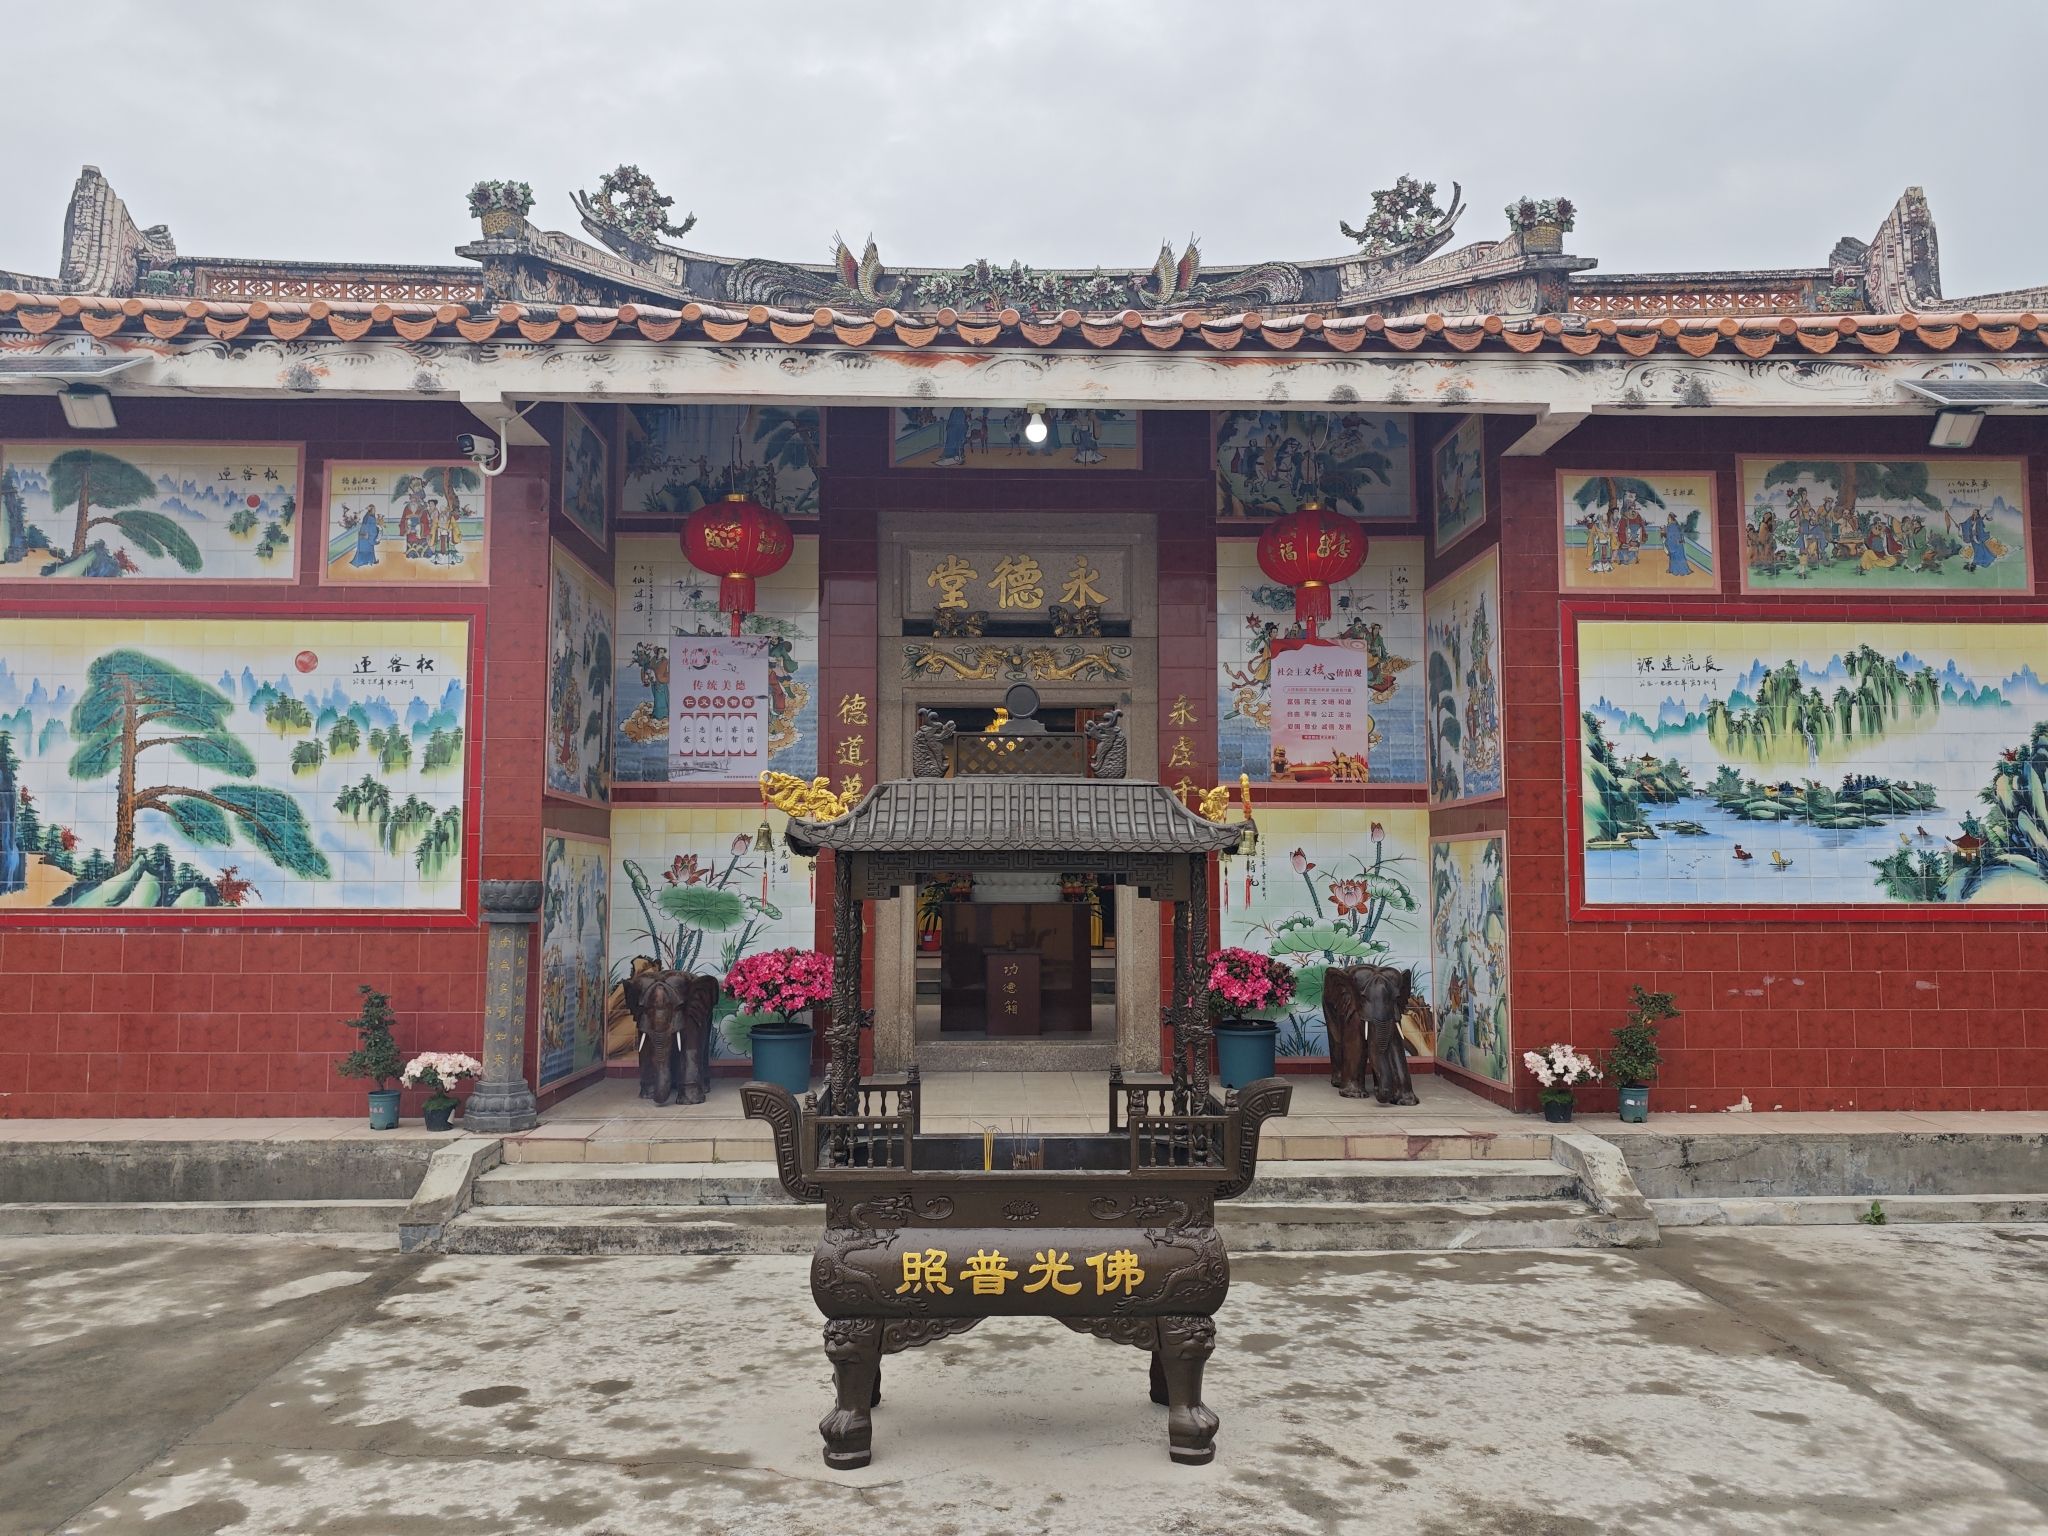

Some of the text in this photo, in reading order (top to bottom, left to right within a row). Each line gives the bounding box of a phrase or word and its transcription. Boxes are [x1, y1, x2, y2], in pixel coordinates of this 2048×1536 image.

[926, 554, 1111, 610] 永德堂
[353, 653, 434, 674] 迎客松
[1277, 664, 1362, 681] 社会主义核心价值观
[693, 680, 746, 691] 传统美德
[1287, 698, 1352, 706] 富强 民主 文明 和谐
[683, 726, 691, 744] 仁爱
[747, 726, 755, 744] 诚信
[1287, 723, 1352, 731] 爱国 敬业 诚信 友善
[1002, 962, 1019, 1015] 功德箱
[895, 1248, 1145, 1296] 佛光普照
